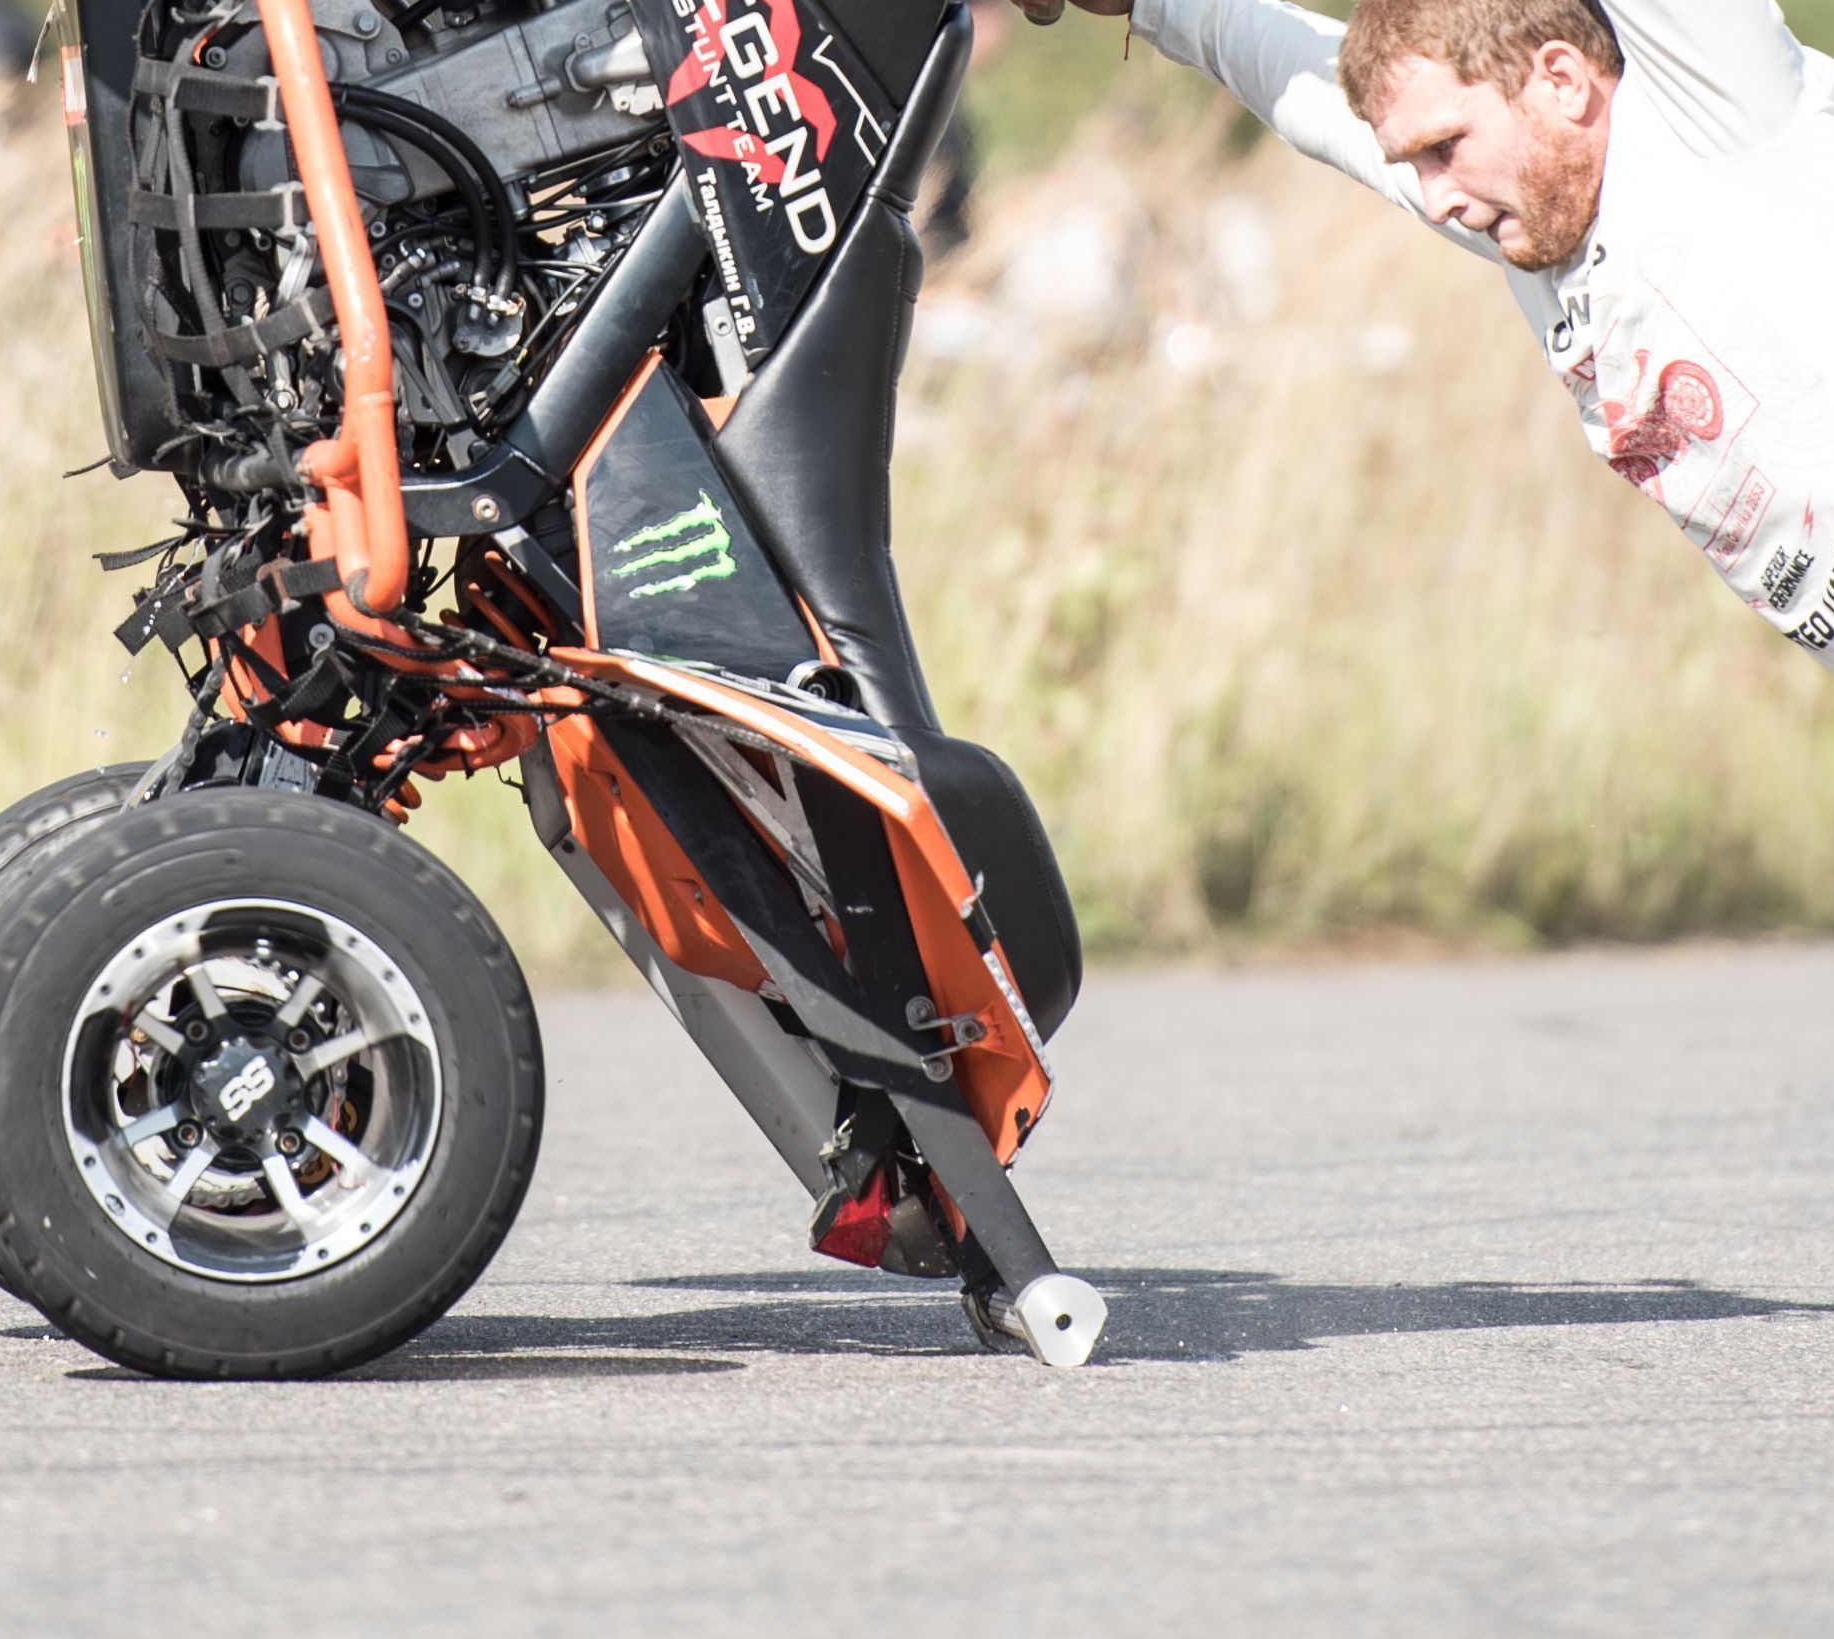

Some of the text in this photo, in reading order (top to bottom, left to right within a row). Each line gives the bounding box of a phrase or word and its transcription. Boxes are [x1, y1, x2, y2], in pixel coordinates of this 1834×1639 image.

[726, 111, 775, 213] TEAM
[696, 167, 741, 293] Талдыкин
[1768, 549, 1814, 610] PERFORMANCE
